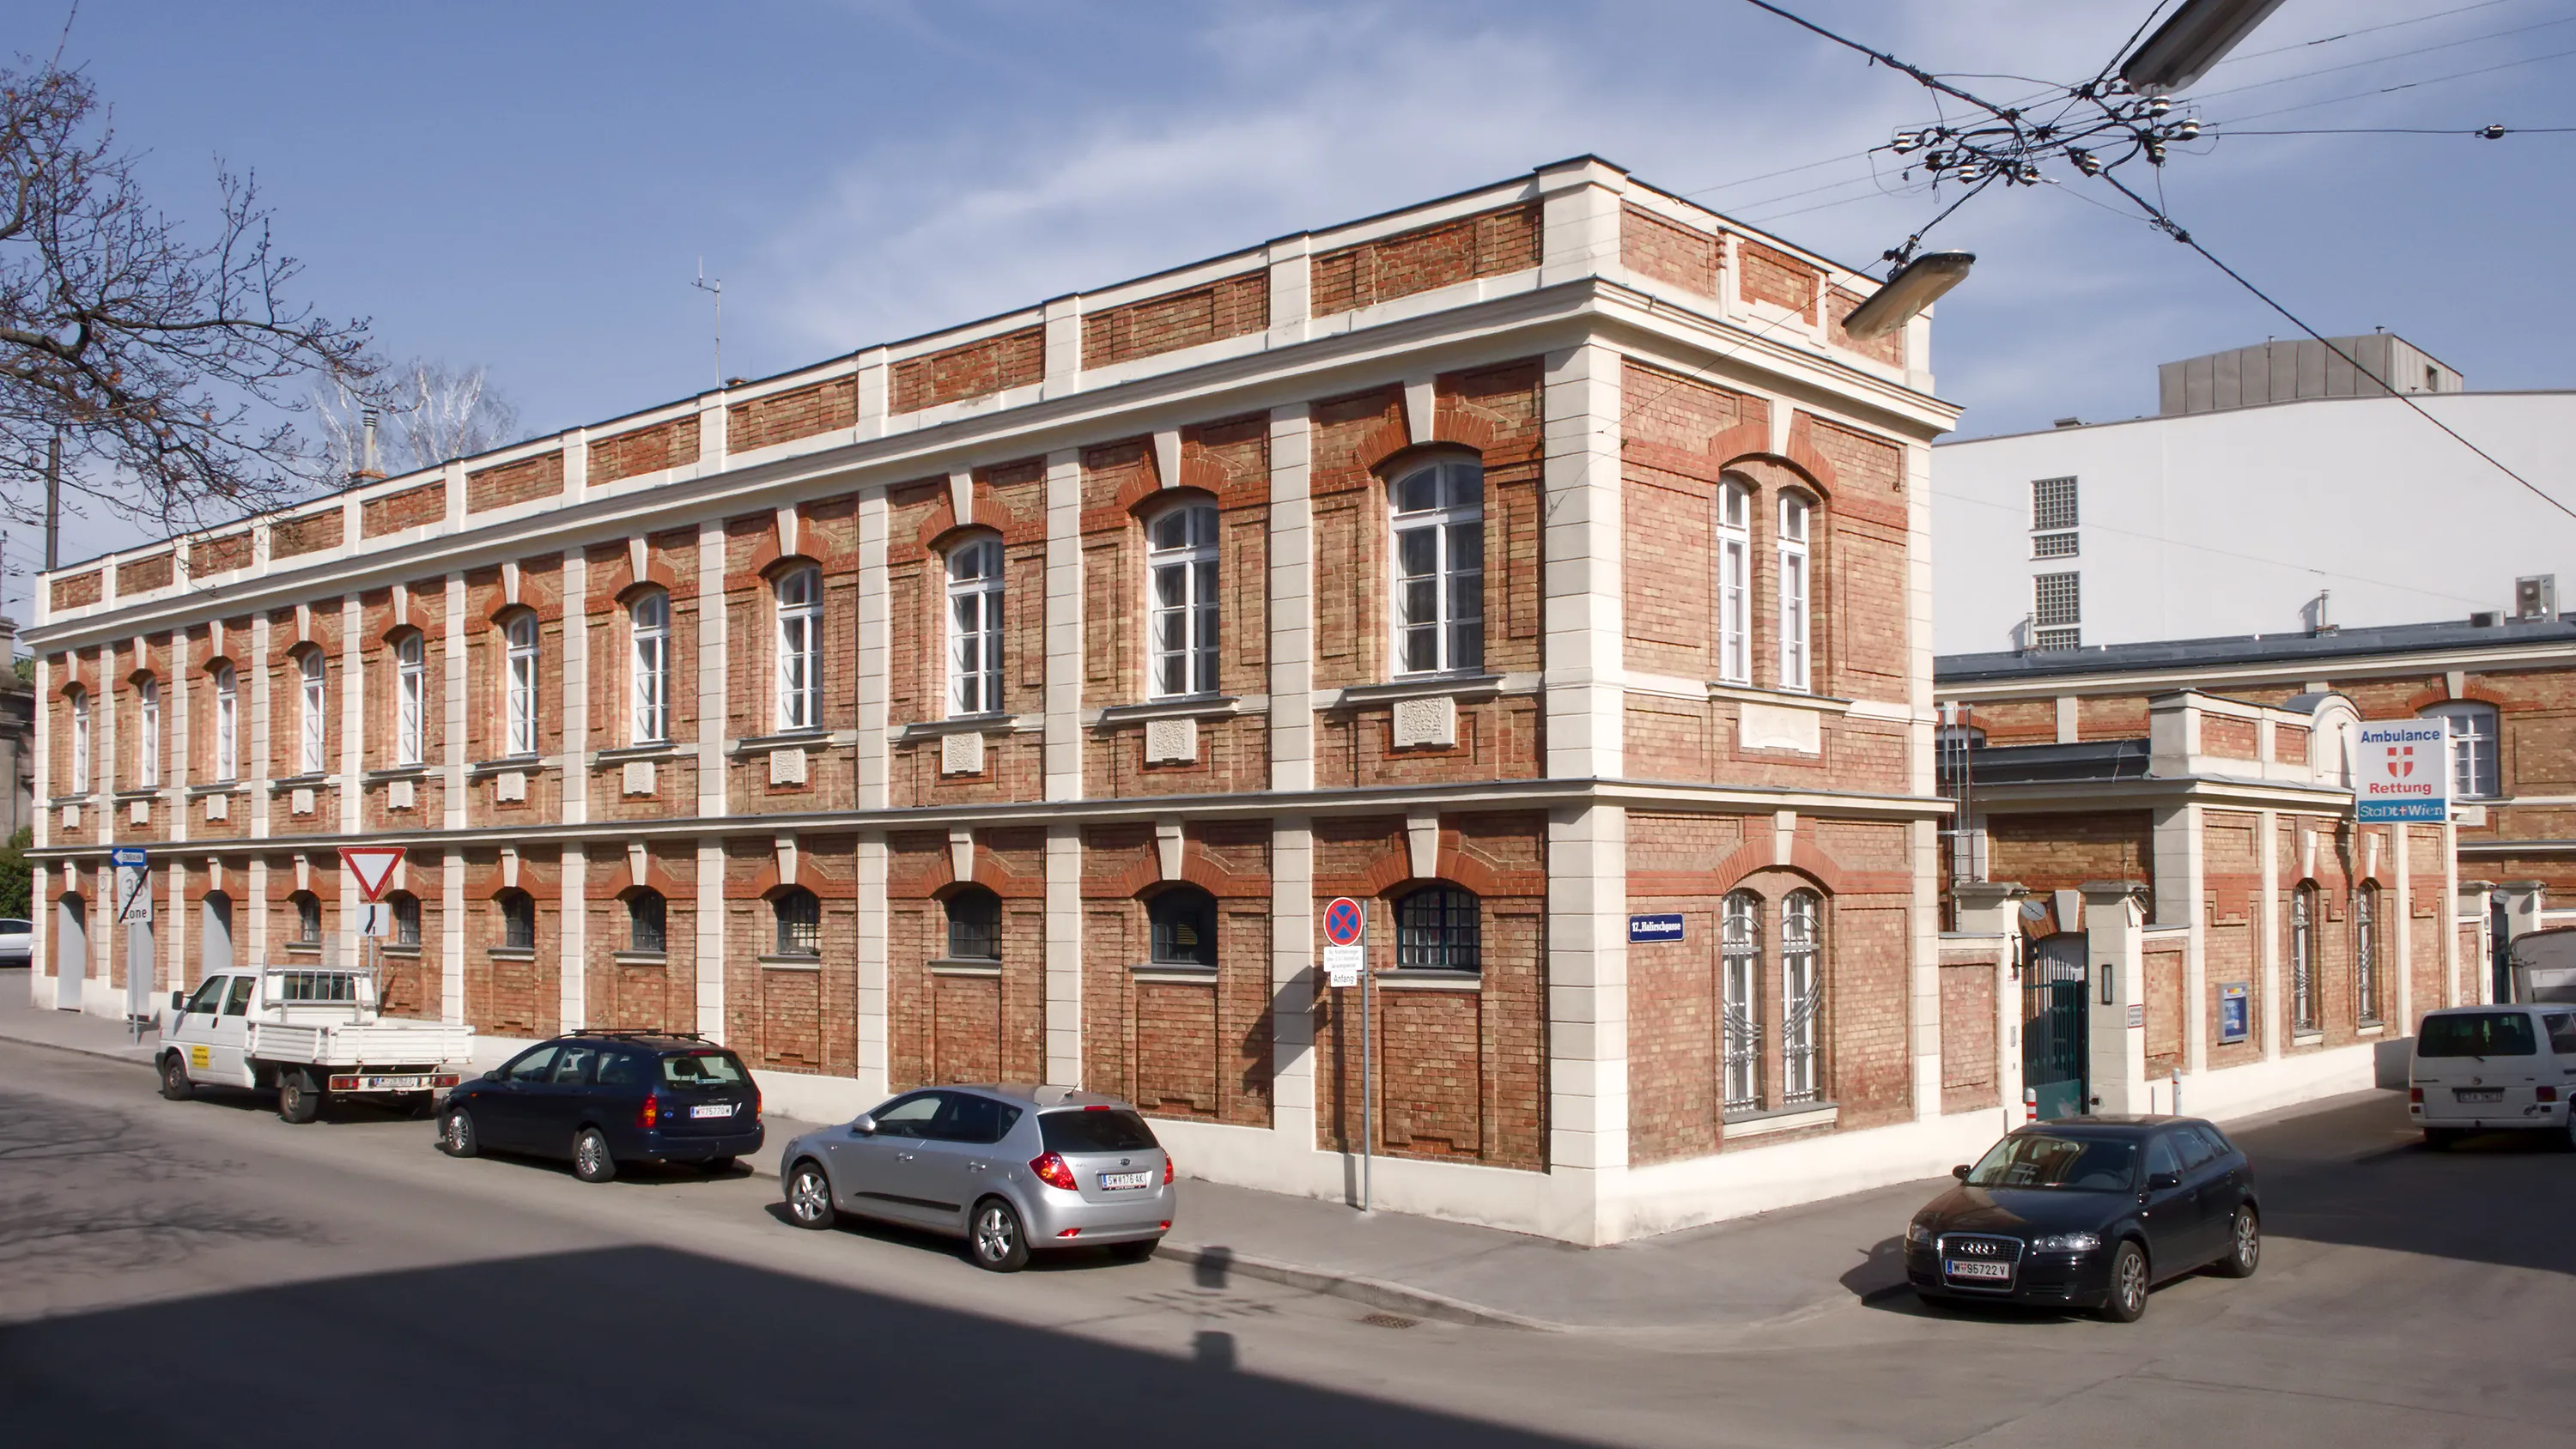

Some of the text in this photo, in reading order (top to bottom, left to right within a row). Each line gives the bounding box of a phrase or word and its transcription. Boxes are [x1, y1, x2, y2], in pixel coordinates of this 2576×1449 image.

[2360, 729, 2440, 743] Ambulance
[2369, 783, 2432, 795] Rettung
[2408, 803, 2445, 816] Wien
[1334, 974, 1354, 985] Anfang
[1967, 1264, 1997, 1276] 95722
